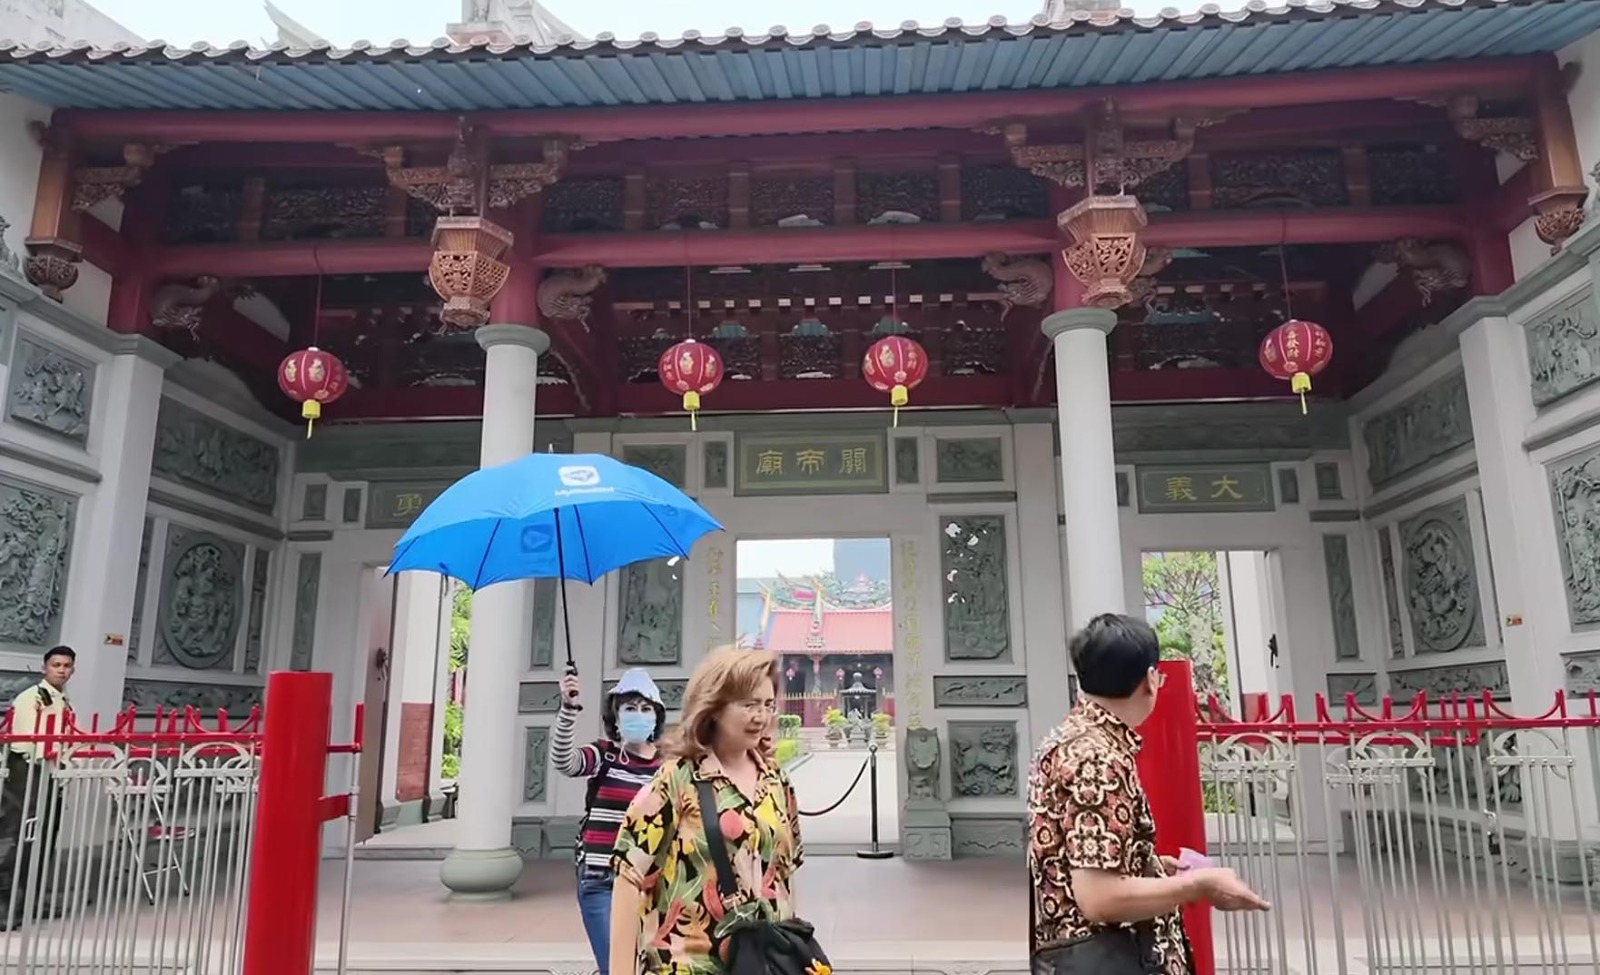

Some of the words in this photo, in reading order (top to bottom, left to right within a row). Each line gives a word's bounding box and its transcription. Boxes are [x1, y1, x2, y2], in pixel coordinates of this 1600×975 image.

[756, 448, 866, 475] 關帝廟
[1165, 475, 1243, 501] 大義
